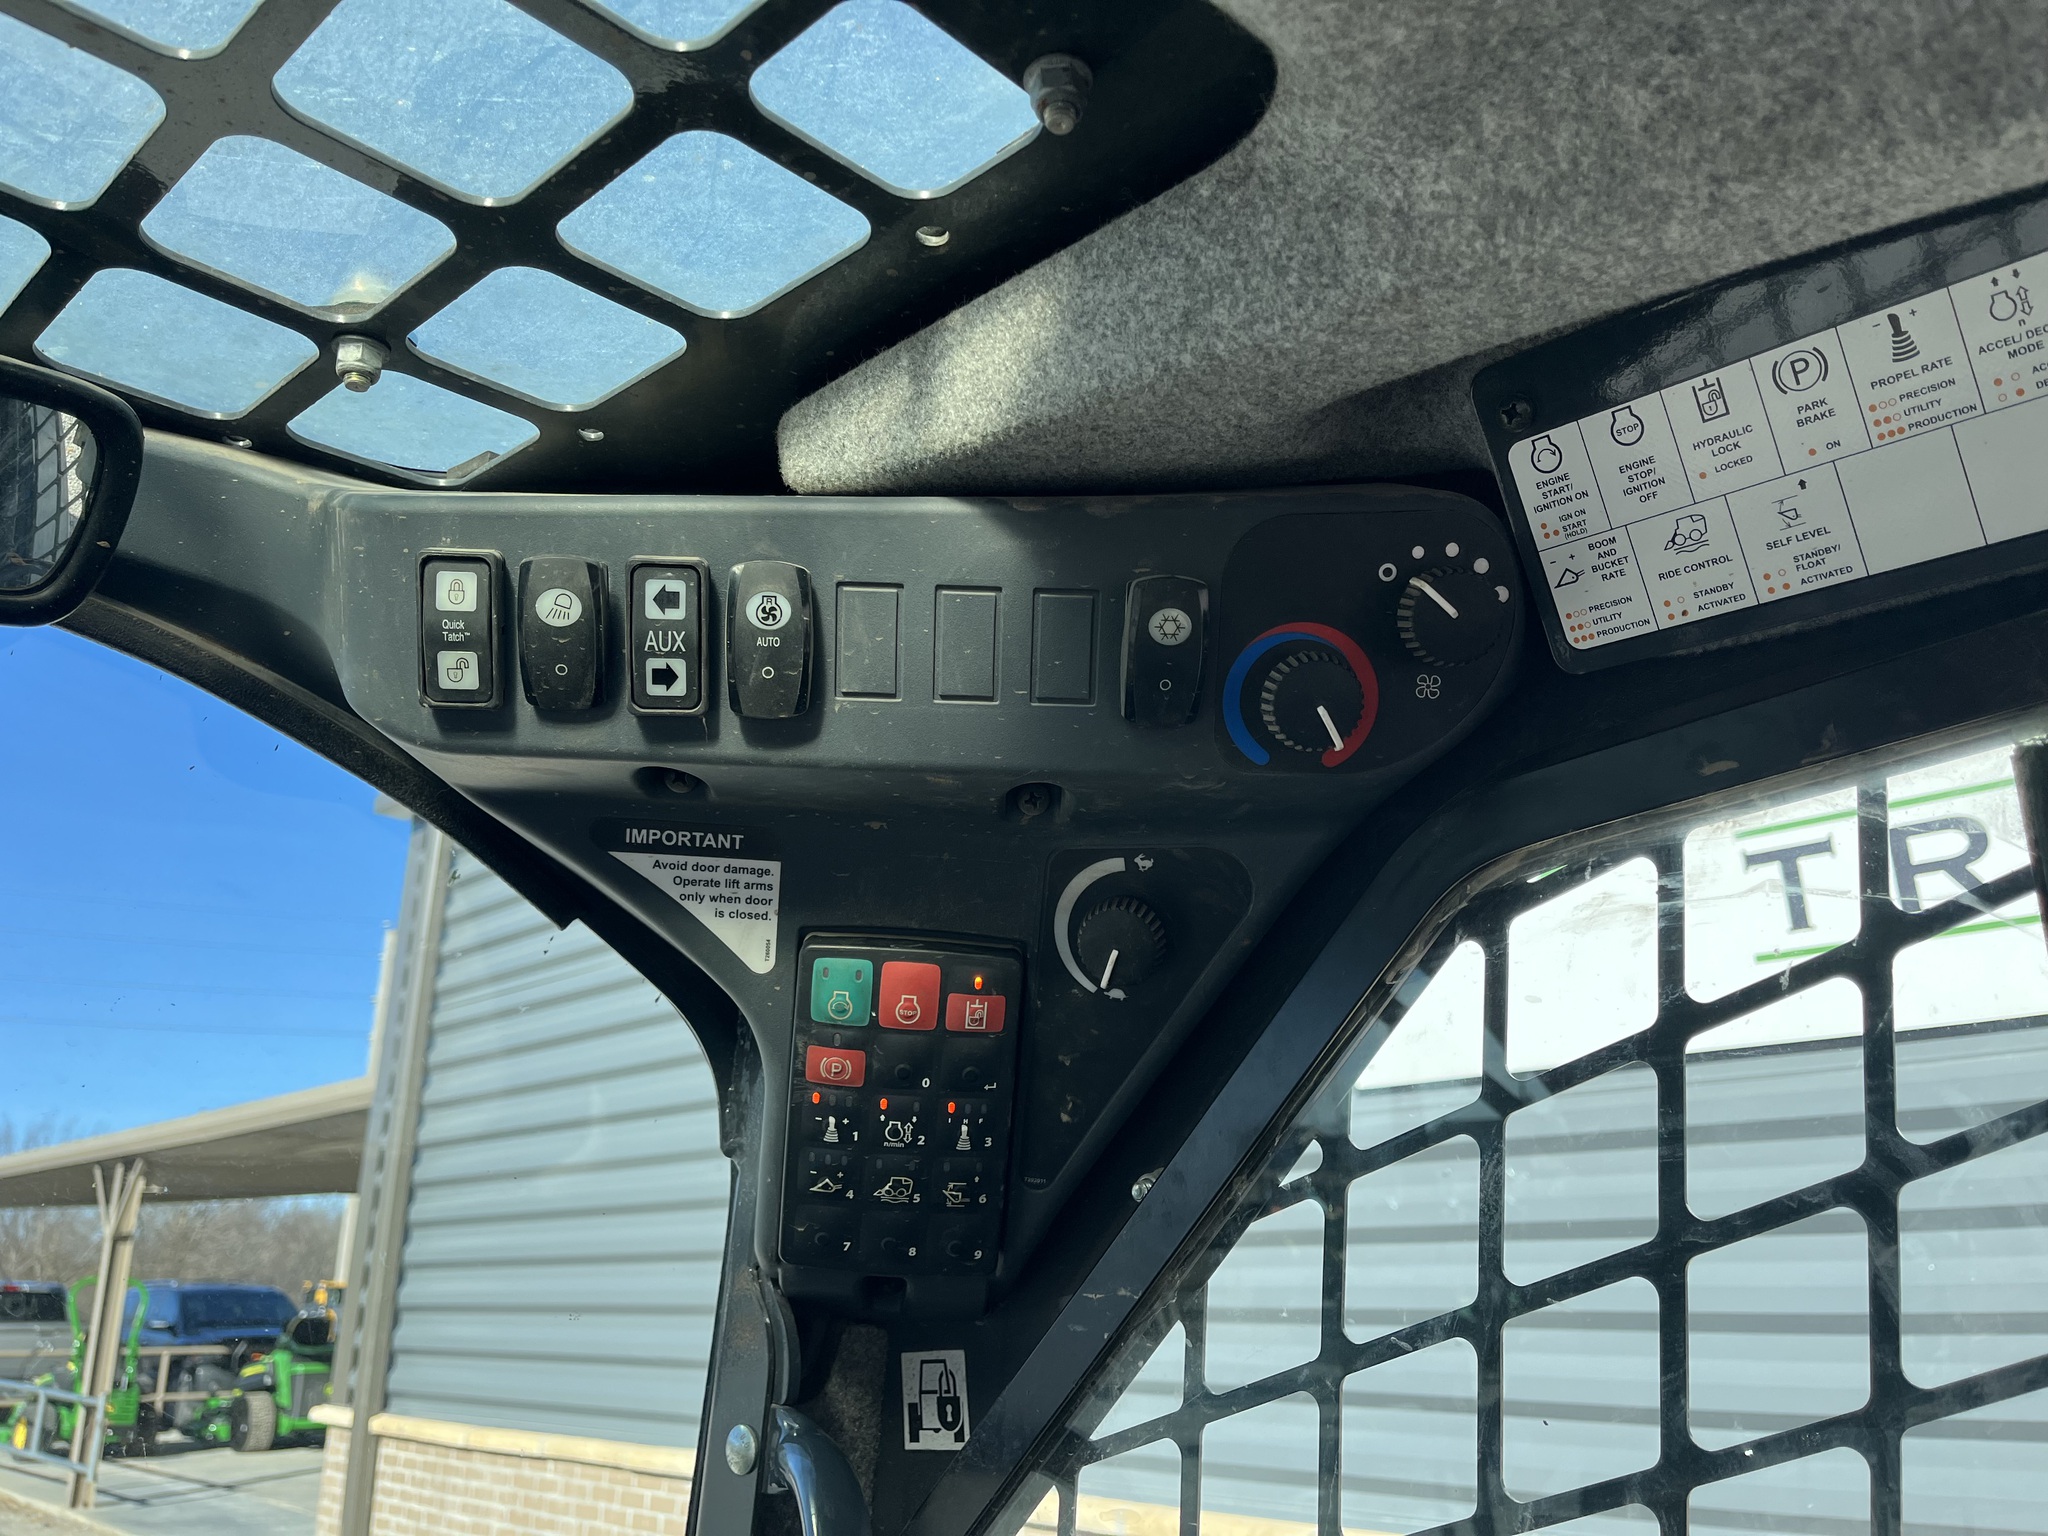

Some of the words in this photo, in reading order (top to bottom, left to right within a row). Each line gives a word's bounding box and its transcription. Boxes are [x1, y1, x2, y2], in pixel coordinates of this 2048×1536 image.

[1978, 332, 2023, 355] ACCEL/
[2007, 340, 2045, 359] MODE
[1789, 358, 1810, 386] P
[1870, 367, 1919, 390] PROPEL
[1921, 356, 1954, 377] RATE
[2031, 361, 2048, 374] AC
[1899, 378, 1956, 402] PRECISION
[1796, 397, 1828, 415] PARK
[1904, 398, 1943, 418] UTILITY
[1796, 408, 1836, 428] BRAKE
[1908, 403, 1978, 432] PRODUCTION
[1615, 423, 1639, 437] STOP
[1692, 424, 1753, 451] HYDRAULIC
[1711, 441, 1741, 457] LOCK
[1825, 439, 1842, 451] ON
[1618, 455, 1656, 474] ENGINE
[1714, 455, 1753, 473] LOCKED
[1535, 472, 1570, 490] ENGINE
[1627, 467, 1656, 483] STOP/
[1541, 483, 1573, 500] START/
[1623, 477, 1665, 497] IGNITION
[1533, 495, 1573, 514] IGNITION
[1574, 489, 1589, 503] ON
[1639, 490, 1659, 503] OFF
[1558, 511, 1572, 523] IGN
[1573, 508, 1586, 519] ON
[1562, 519, 1587, 533] START
[1564, 527, 1588, 540] (HOLD)
[1587, 536, 1617, 551] BOOM
[1765, 534, 1793, 551] SELF
[1795, 526, 1831, 544] LEVEL
[1597, 548, 1617, 560] AND
[1793, 543, 1841, 564] STANDBY/
[1591, 556, 1629, 574] BUCKET
[1658, 565, 1682, 581] RIDE
[1683, 554, 1733, 575] CONTROL
[1795, 557, 1827, 572] FLOAT
[1601, 568, 1627, 582] RATE
[1800, 565, 1854, 586] ACTIVATED
[1693, 582, 1735, 600] STANDBY
[1588, 595, 1633, 613] PRECISION
[1697, 593, 1746, 612] ACTIVATED
[442, 619, 465, 631] Quick
[1592, 611, 1623, 626] UTILITY
[1596, 618, 1651, 638] PRODUCTION
[645, 630, 686, 653] AUX
[756, 637, 780, 648] AUTO
[625, 828, 744, 850] IMPORTANT
[652, 859, 688, 872] Avoid
[691, 862, 720, 873] door
[723, 864, 774, 878] damage.
[673, 876, 721, 889] Operate
[724, 878, 740, 889] lift
[743, 881, 774, 891] arms
[679, 892, 706, 904] only
[709, 893, 741, 904] when
[745, 895, 774, 906] door
[714, 908, 725, 918] is
[728, 909, 772, 921] closed.
[831, 1062, 842, 1077] P
[921, 1078, 930, 1088] 0
[852, 1131, 858, 1141] 1
[917, 1135, 926, 1145] 2
[984, 1137, 992, 1147] 3
[845, 1189, 854, 1199] 4
[912, 1194, 921, 1203] 5
[978, 1194, 987, 1203] 6
[843, 1241, 852, 1251] 7
[908, 1247, 917, 1256] 8
[973, 1250, 983, 1259] 9
